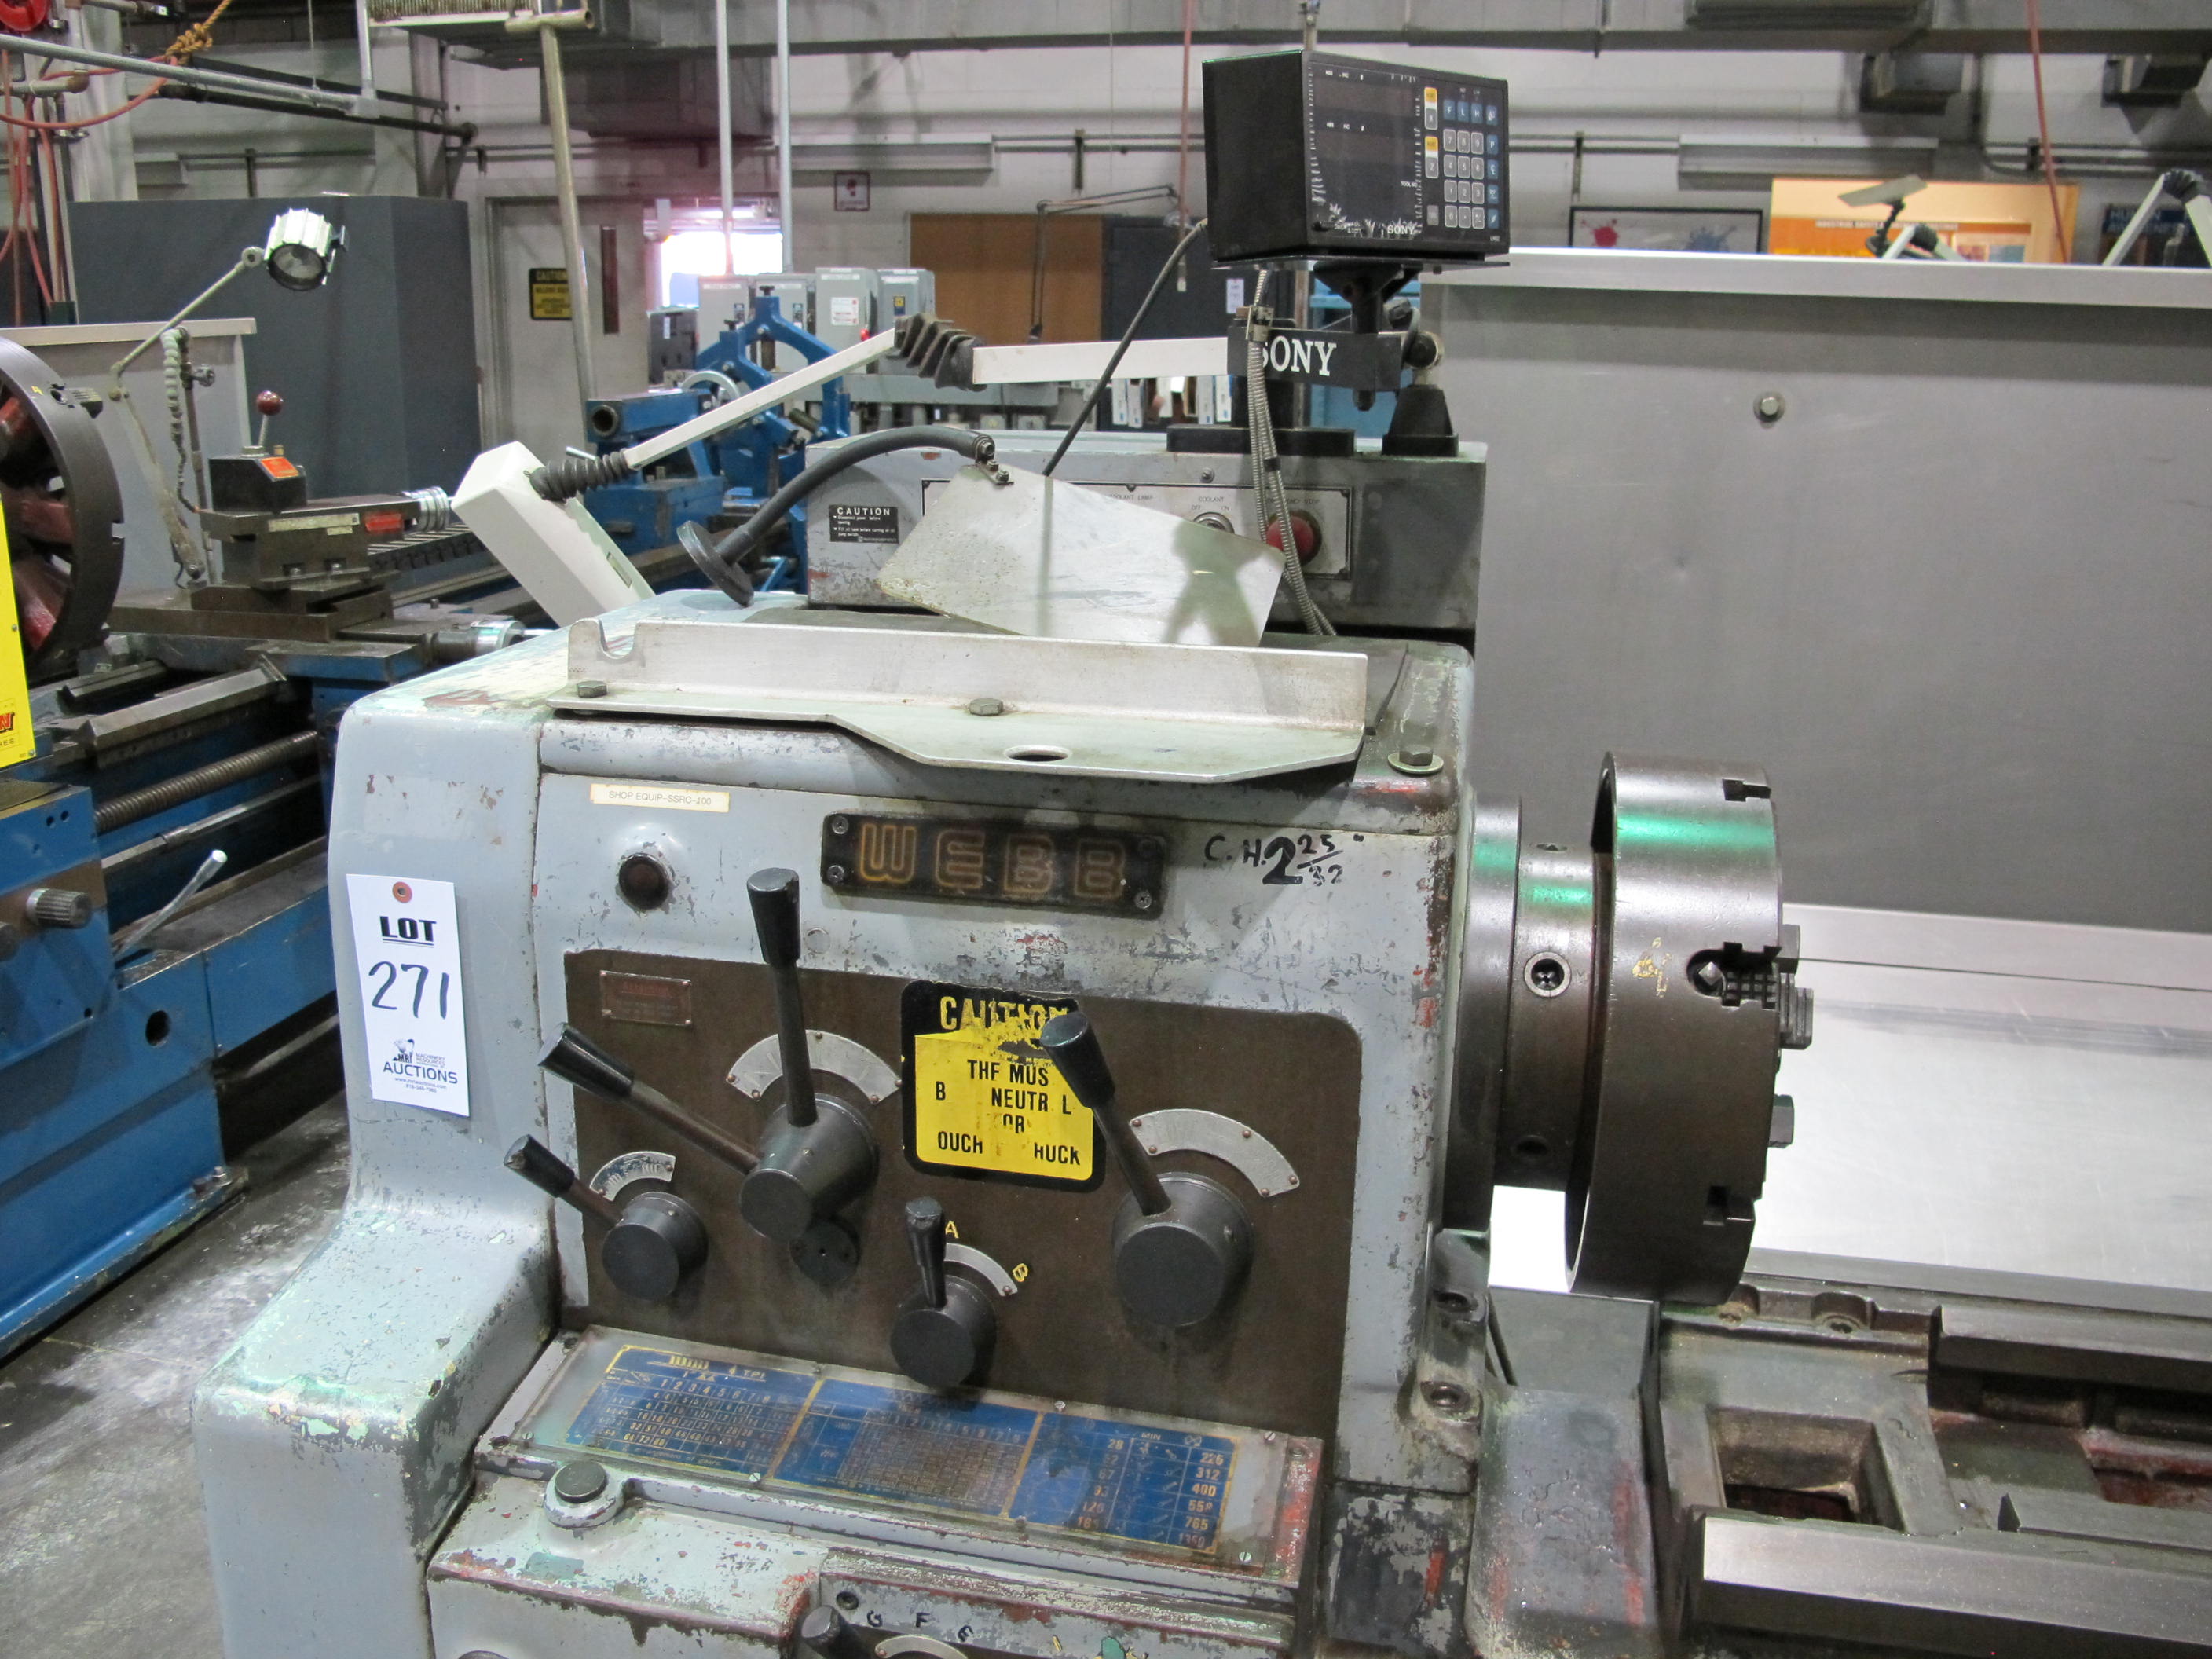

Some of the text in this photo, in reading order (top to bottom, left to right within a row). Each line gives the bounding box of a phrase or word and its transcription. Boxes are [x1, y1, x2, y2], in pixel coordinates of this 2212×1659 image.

[1387, 225, 1415, 235] SONY
[837, 507, 891, 516] CAUTION
[609, 790, 633, 800] SHOP
[859, 823, 1126, 898] WEBB
[379, 915, 438, 943] LOT
[368, 961, 450, 1020] 271
[383, 1061, 458, 1084] AUCTIONS
[945, 1221, 959, 1239] A
[674, 1381, 683, 1390] 2
[688, 1383, 697, 1392] 3
[1108, 1438, 1124, 1450] 28
[1196, 1467, 1221, 1481] 312
[1192, 1483, 1217, 1497] 400
[1185, 1515, 1209, 1531] 765
[866, 1610, 974, 1643] G F E
